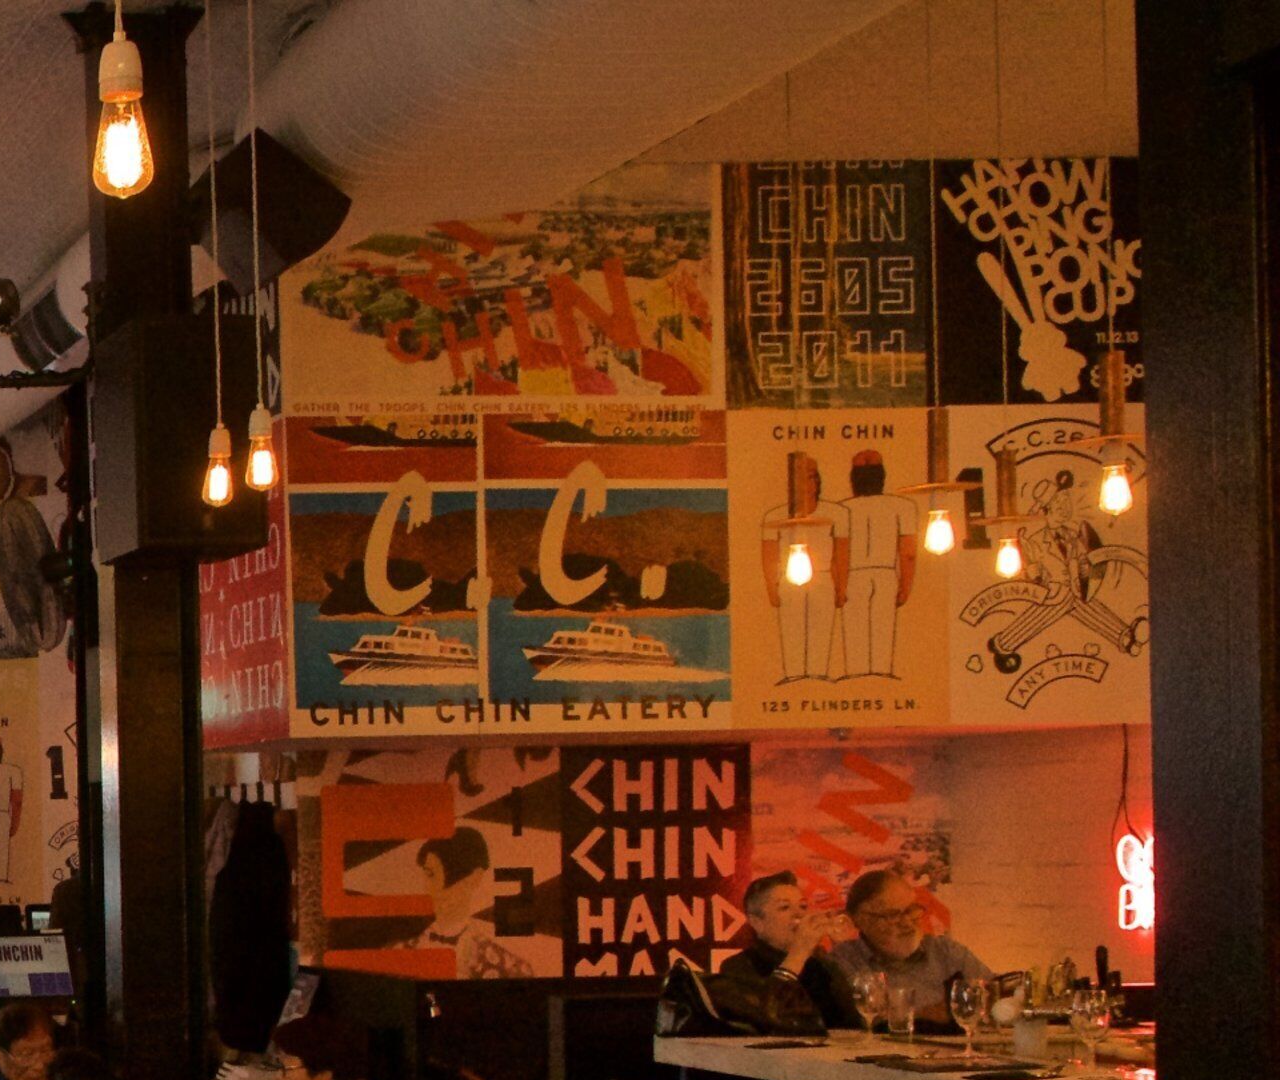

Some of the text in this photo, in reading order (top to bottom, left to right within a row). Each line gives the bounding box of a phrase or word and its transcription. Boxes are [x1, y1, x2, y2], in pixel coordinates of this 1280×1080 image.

[758, 184, 906, 243] CHIN
[1043, 278, 1135, 324] CUP
[757, 330, 907, 390] 2011
[292, 402, 340, 413] GATHER
[349, 402, 370, 413] THE
[436, 402, 466, 413] CHIN
[473, 402, 502, 413] CHIN
[773, 424, 895, 441] CHIN CHIN
[968, 585, 1039, 618] ORIGINAL
[1018, 660, 1096, 698] ANY TIME
[310, 694, 717, 727] CHIN CHIN EATERY
[762, 702, 790, 712] 125
[801, 700, 884, 712] FLINDERS
[570, 758, 736, 814] CHIN
[571, 825, 737, 882] CHIN
[576, 894, 747, 945] HAND
